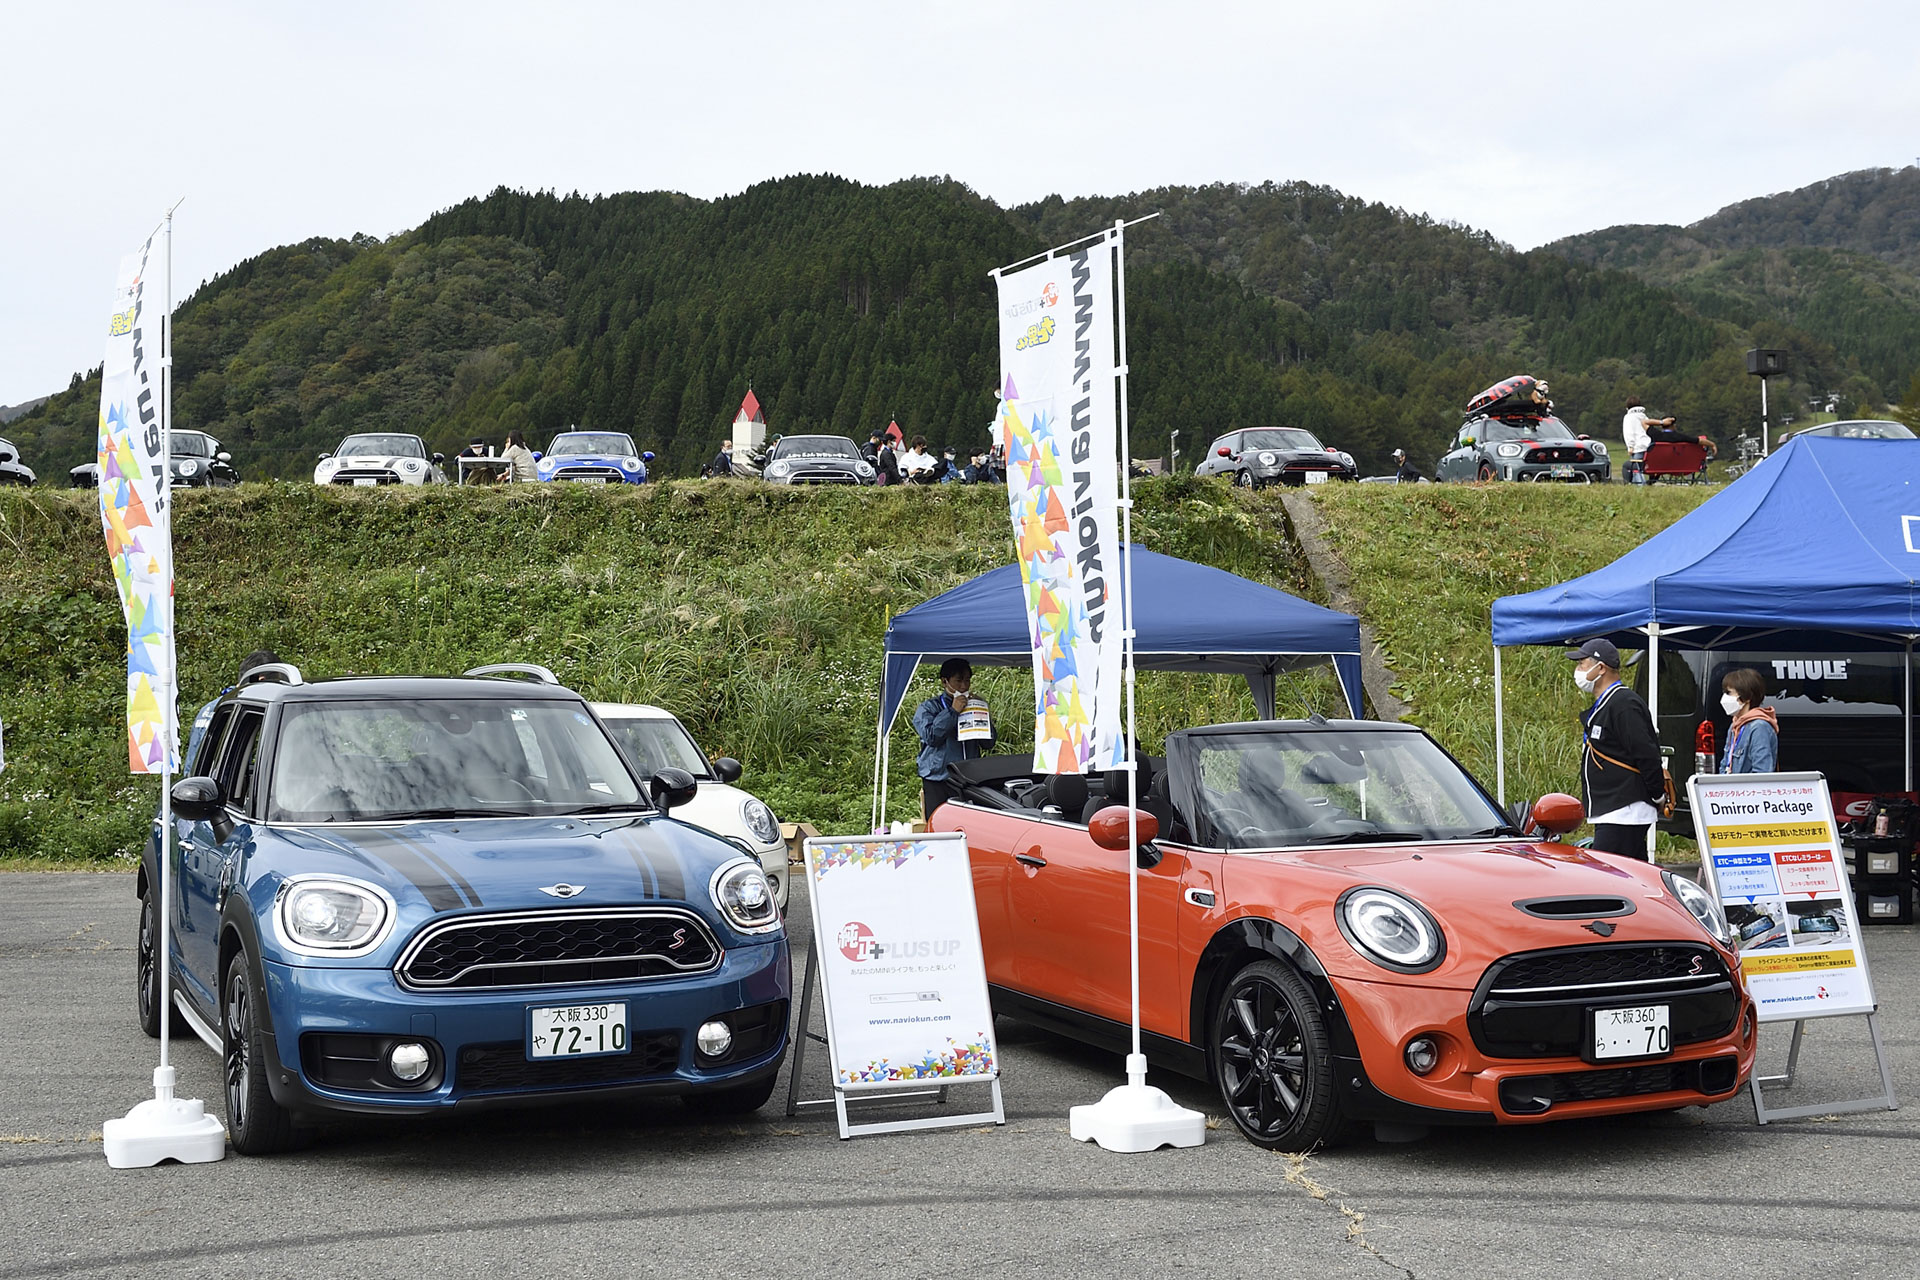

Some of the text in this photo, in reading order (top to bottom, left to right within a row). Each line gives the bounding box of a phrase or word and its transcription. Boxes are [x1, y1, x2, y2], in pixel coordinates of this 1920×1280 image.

[1771, 660, 1848, 680] THULE
[1711, 800, 1813, 815] Dmirror Package
[669, 928, 686, 949] S
[933, 940, 960, 957] UP
[1688, 955, 1703, 975] S
[1761, 995, 1815, 1003] www.naviokun.com
[869, 1014, 951, 1025] www.naviokun.com
[533, 1023, 625, 1055] や 72-10
